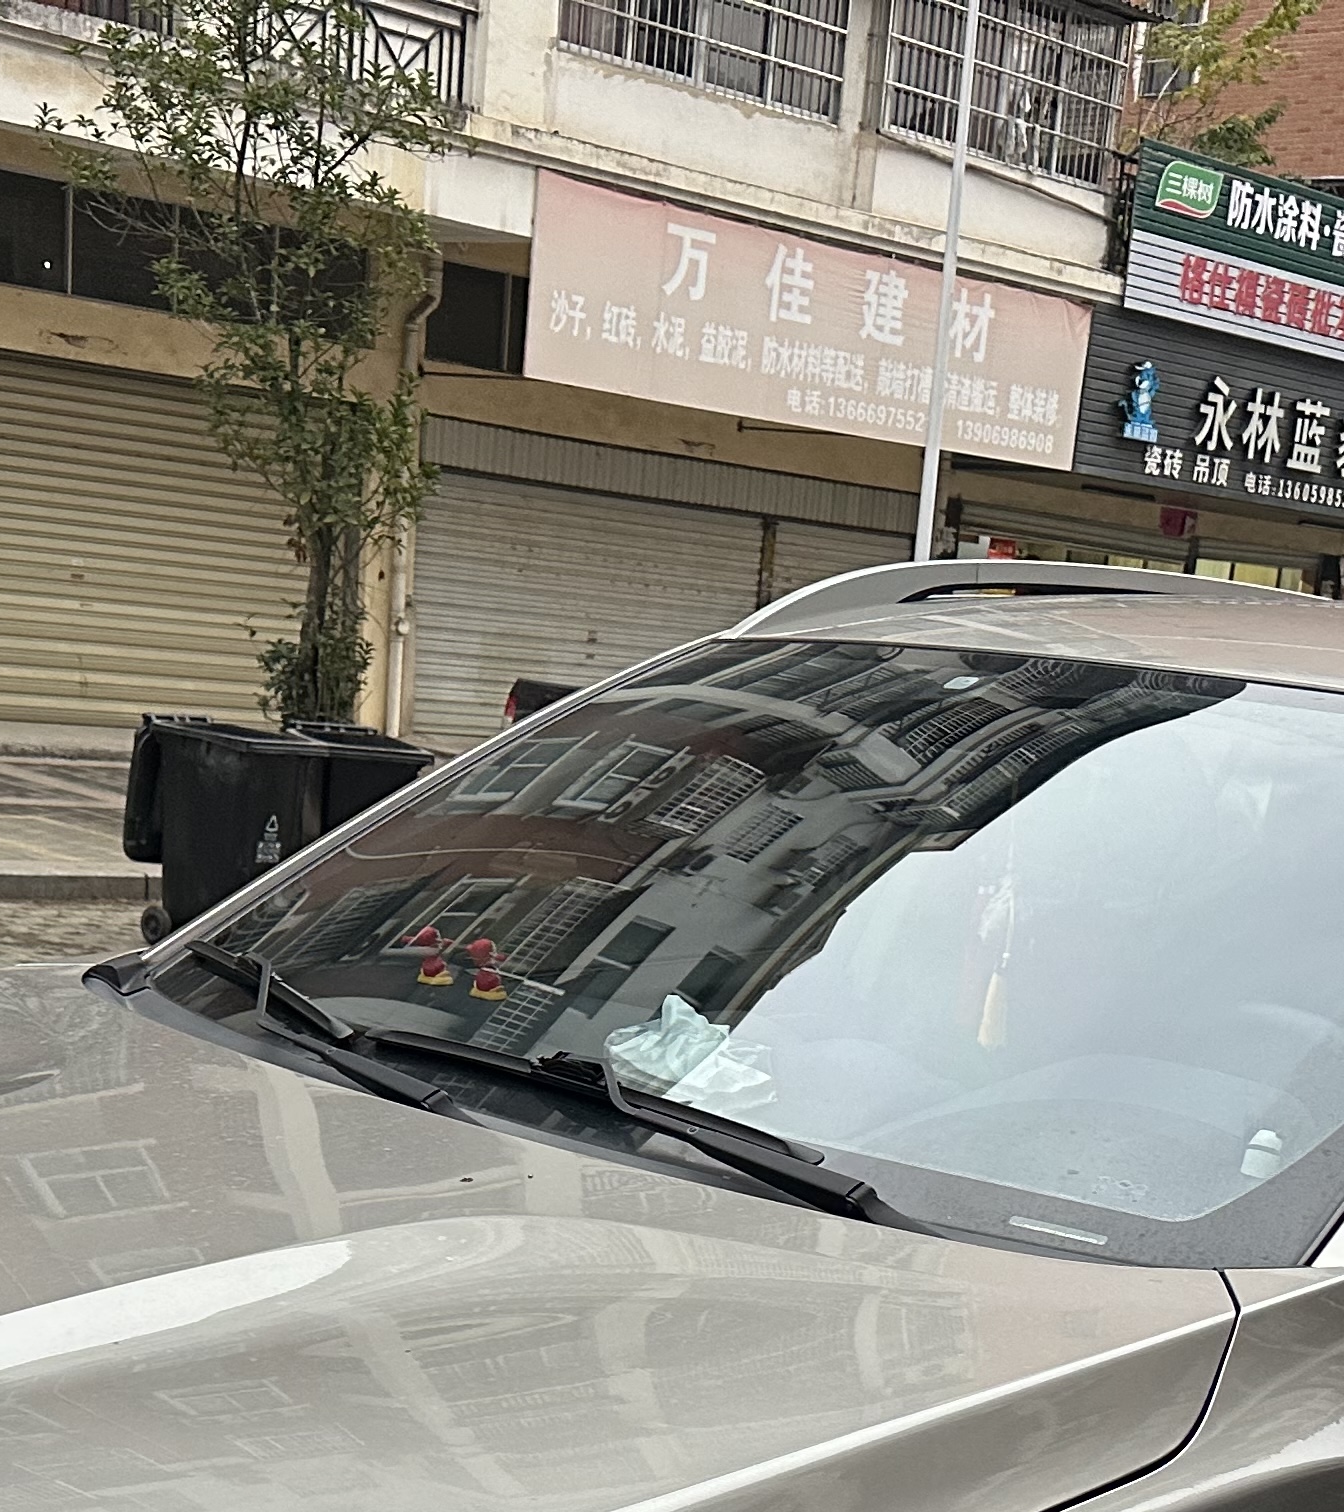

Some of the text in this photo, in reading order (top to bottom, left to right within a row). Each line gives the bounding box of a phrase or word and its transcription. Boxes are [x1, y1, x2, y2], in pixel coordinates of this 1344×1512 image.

[1167, 171, 1214, 205] 三棵树
[661, 222, 995, 363] 万佳建材
[787, 386, 1054, 454] 电话:1366697552 13906986908
[1144, 446, 1184, 479] 瓷砖
[1192, 453, 1231, 487] 吊顶
